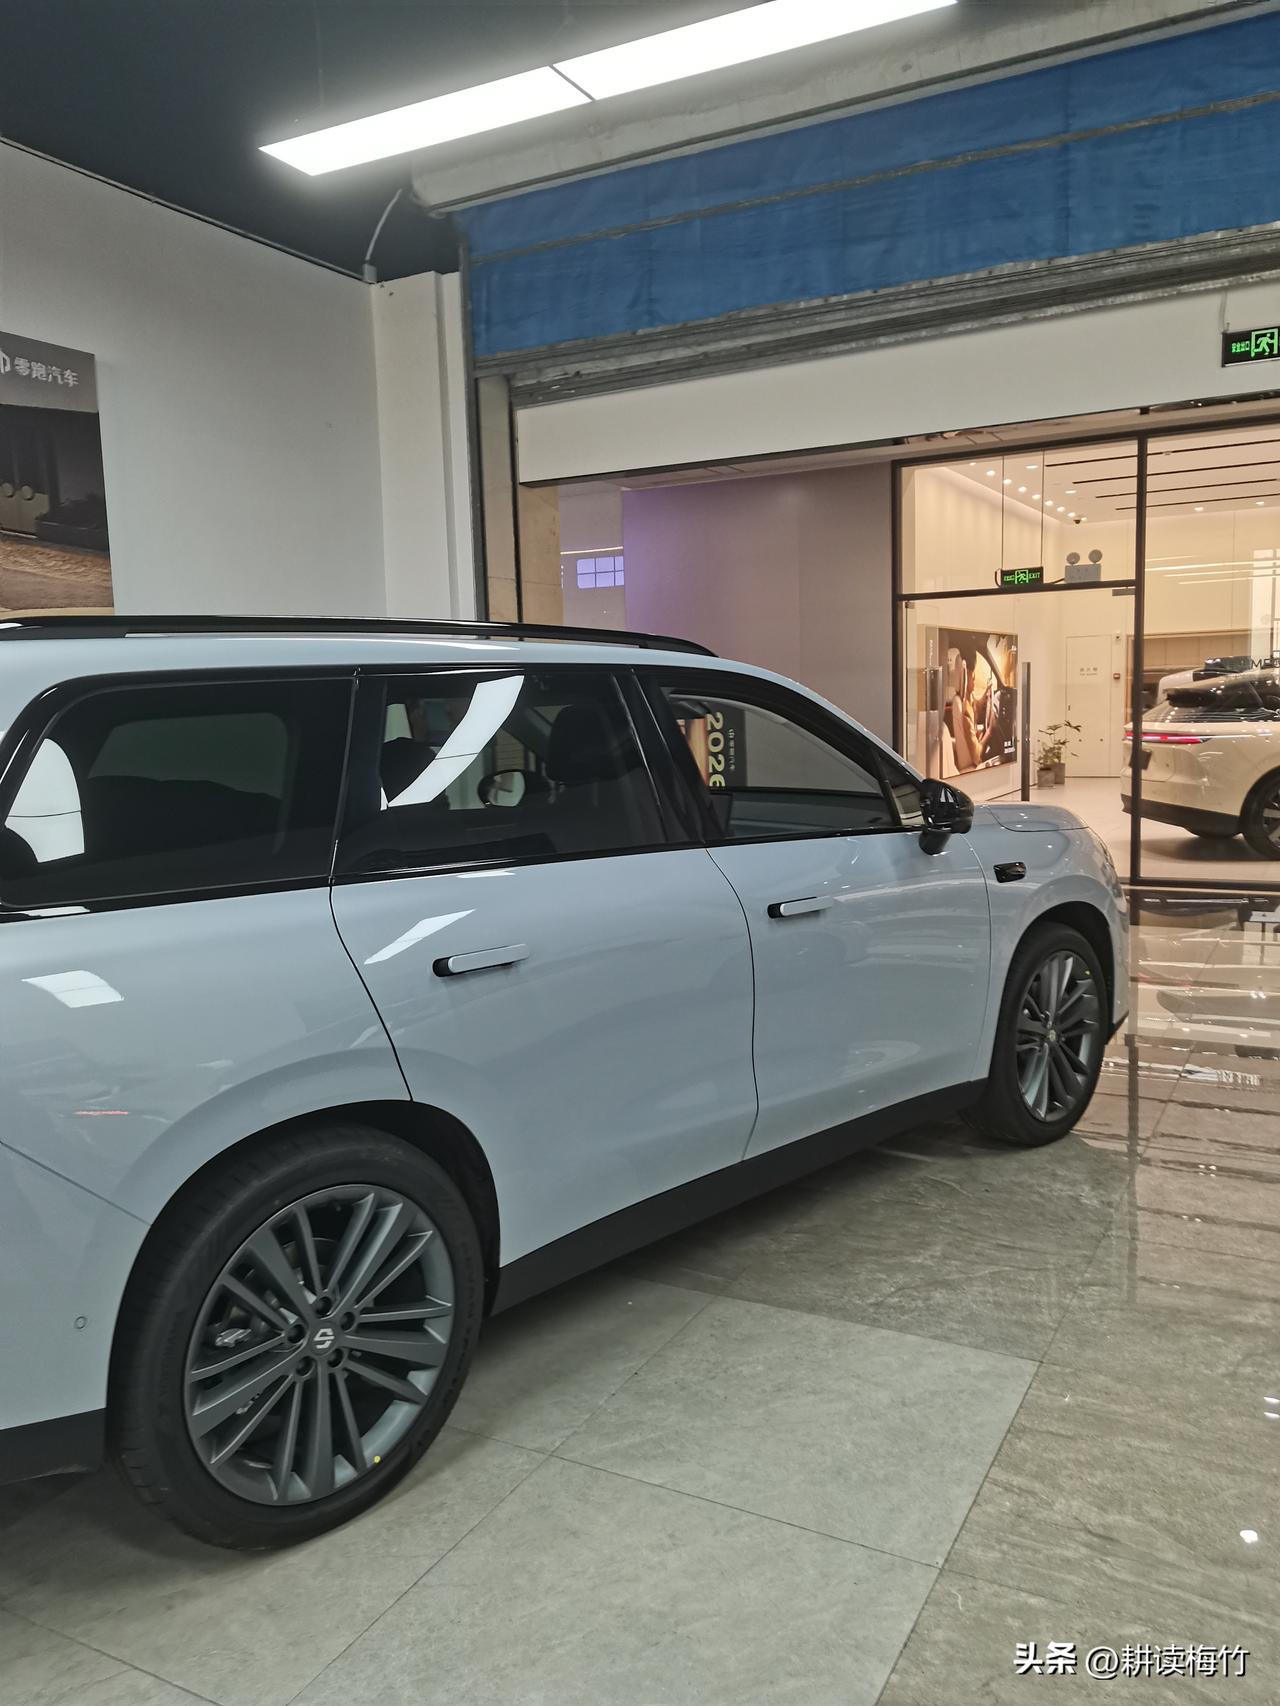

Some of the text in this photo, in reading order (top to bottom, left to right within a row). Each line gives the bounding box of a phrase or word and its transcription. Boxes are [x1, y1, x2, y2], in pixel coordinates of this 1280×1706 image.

[14, 356, 79, 388] 零跑汽车
[706, 711, 726, 787] 2026
